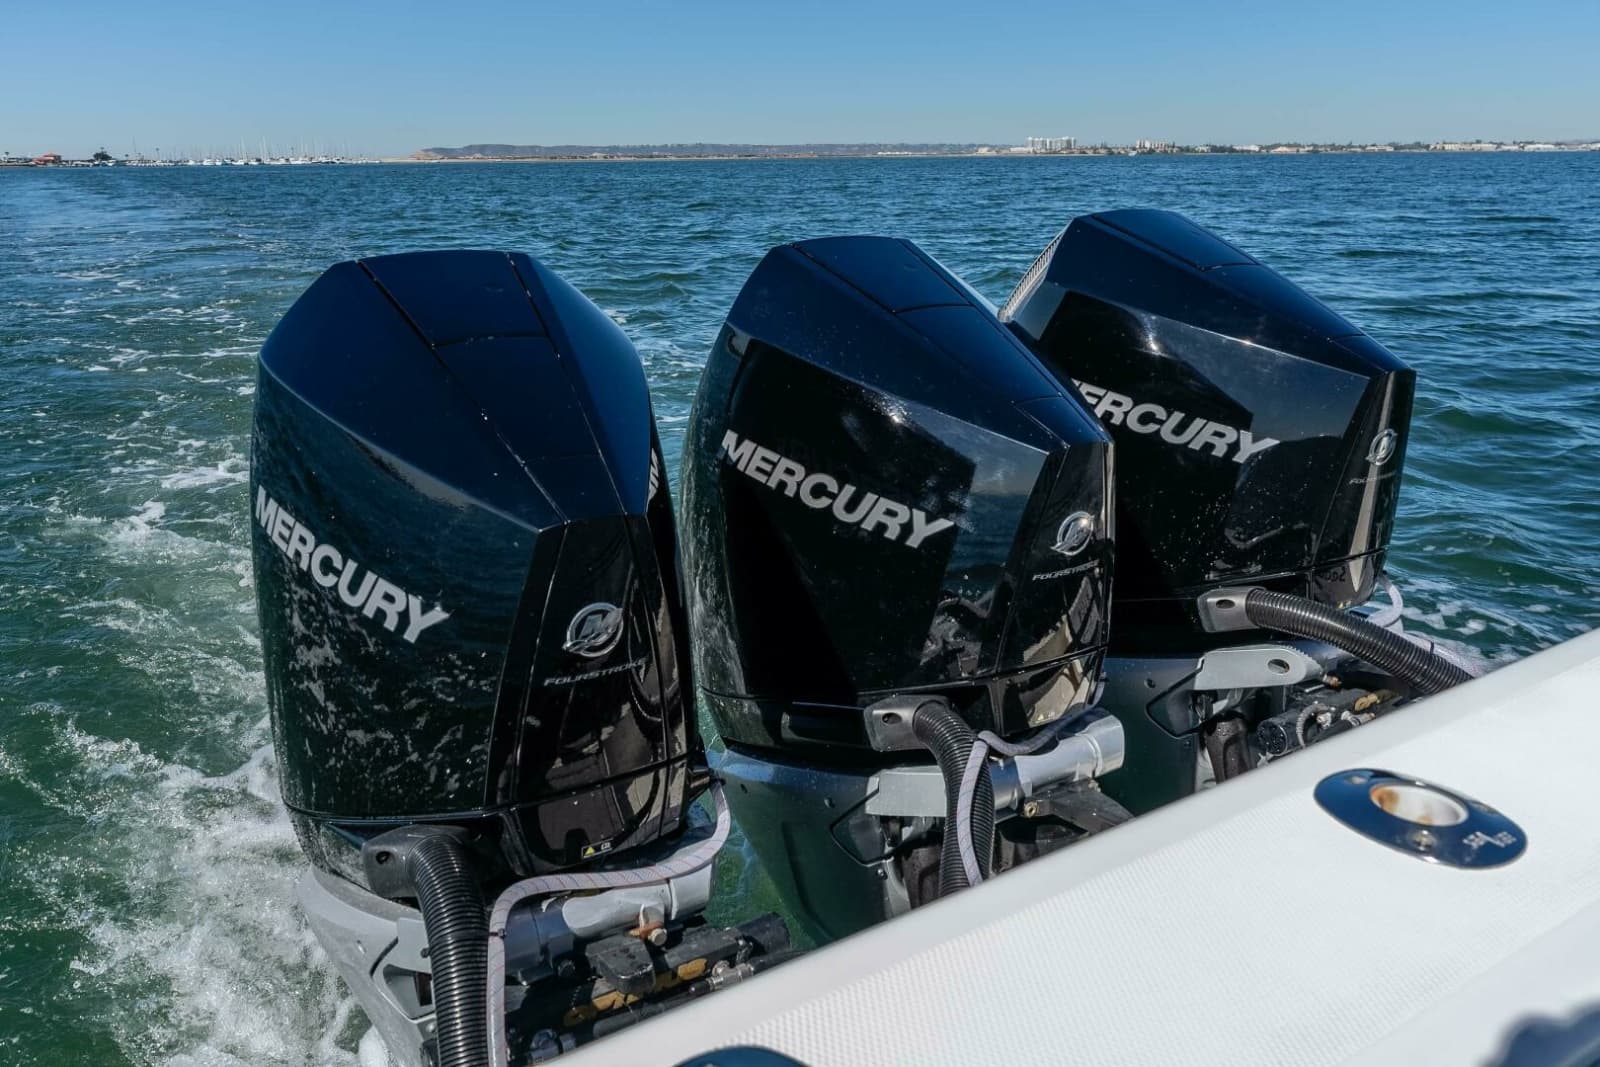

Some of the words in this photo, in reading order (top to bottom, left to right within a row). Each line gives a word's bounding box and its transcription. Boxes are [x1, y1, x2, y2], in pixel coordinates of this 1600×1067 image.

[1071, 378, 1280, 464] ERCURY
[721, 429, 955, 549] MERCURY
[256, 484, 450, 644] MERCURY
